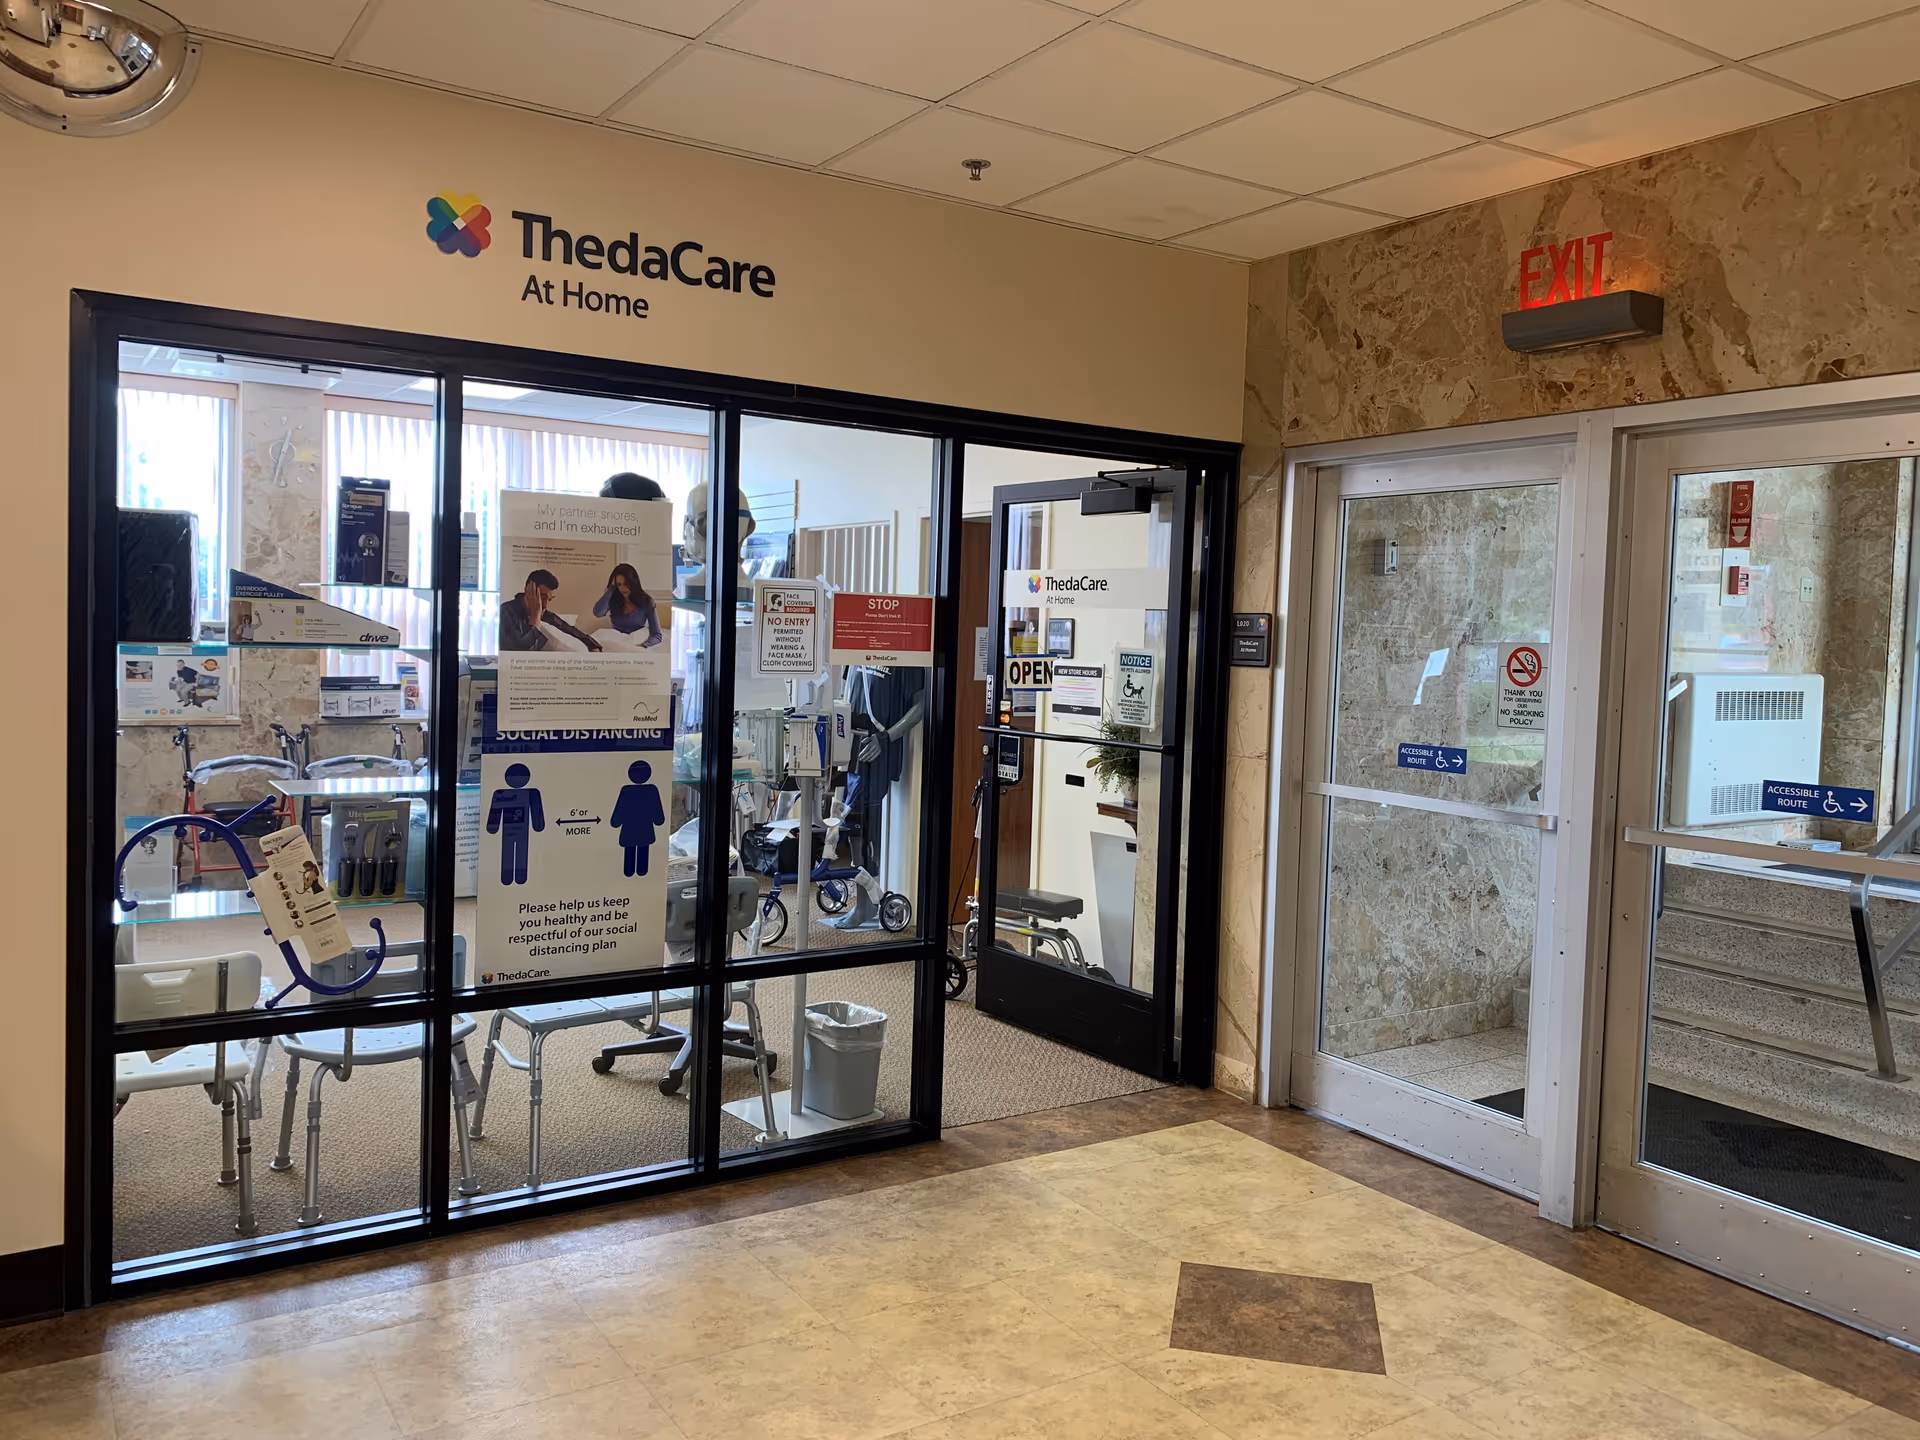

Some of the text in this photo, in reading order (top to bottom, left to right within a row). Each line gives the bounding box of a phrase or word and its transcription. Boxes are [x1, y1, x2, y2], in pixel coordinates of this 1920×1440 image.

[512, 210, 775, 298] ThedaCare
[1519, 231, 1613, 311] EXIT
[521, 275, 649, 318] At Home
[537, 503, 639, 523] My partner snores,
[534, 520, 641, 536] and I'm exhausted!
[1045, 576, 1107, 591] ThedaCare
[868, 598, 899, 610] STOP
[1046, 595, 1074, 604] At Home
[767, 617, 810, 626] NO ENTRY
[359, 633, 389, 642] drive
[1121, 655, 1151, 666] NOTICE
[1009, 660, 1053, 685] OPEN
[1513, 709, 1544, 717] SMOKING
[496, 727, 662, 741] SOCIAL DISTANCING
[1401, 747, 1434, 757] ACCESSIBLE
[1407, 757, 1427, 765] ROUTE
[998, 770, 1017, 779] DEALER
[1767, 785, 1820, 798] ACCESSIBLE
[1777, 798, 1808, 809] ROUTE
[570, 808, 578, 817] 6'
[565, 827, 591, 835] MORE
[518, 896, 630, 914] Please help us keep
[519, 910, 629, 931] you healthy and be
[508, 922, 638, 945] respectful of our social
[529, 940, 617, 957] distancing plan
[496, 969, 550, 982] ThedaCare
